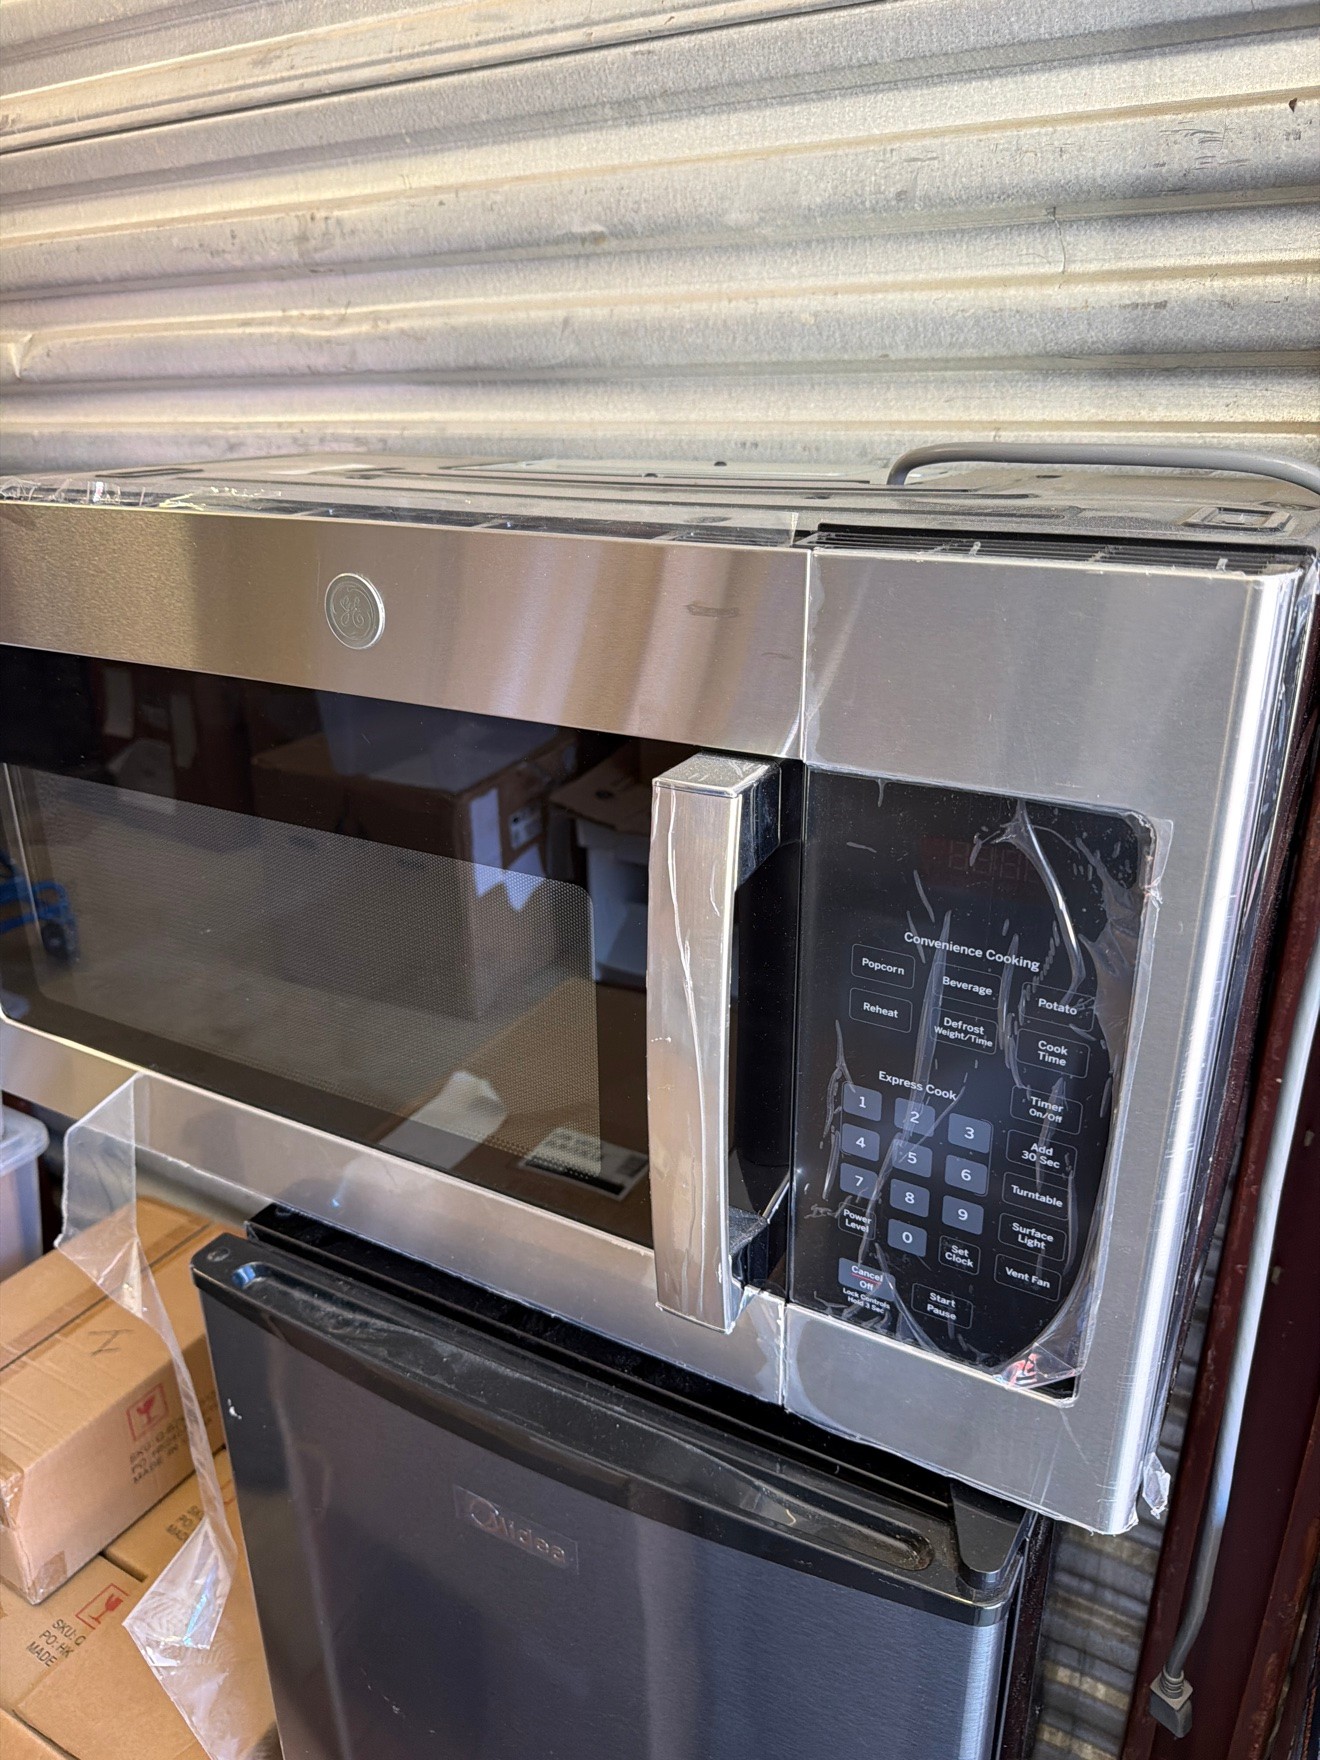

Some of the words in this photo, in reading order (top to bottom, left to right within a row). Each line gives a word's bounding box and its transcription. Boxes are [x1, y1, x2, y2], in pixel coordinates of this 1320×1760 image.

[904, 932, 983, 958] Convenience
[986, 949, 1041, 973] Cooking
[861, 957, 905, 975] Popcorn
[942, 976, 993, 996] Beverage
[863, 1002, 898, 1018] Reheat
[1038, 998, 1078, 1016] Potato
[943, 1017, 985, 1035] Defrost
[934, 1025, 993, 1047] Weight/Time
[1038, 1040, 1068, 1056] Cook
[1037, 1052, 1067, 1067] Time
[878, 1070, 923, 1091] Express
[925, 1083, 957, 1101] Cook
[859, 1096, 867, 1108] 1
[1030, 1096, 1064, 1113] Timer
[910, 1111, 920, 1124] 2
[1029, 1108, 1063, 1124] On/Off
[964, 1127, 975, 1140] 3
[855, 1137, 866, 1148] 4
[1031, 1142, 1054, 1157] Add
[907, 1152, 918, 1164] 5
[1021, 1151, 1036, 1162] 30
[1038, 1155, 1061, 1169] Sec
[854, 1175, 864, 1187] 7
[961, 1169, 972, 1181] 6
[905, 1192, 915, 1204] 8
[1011, 1185, 1063, 1208] Turntable
[843, 1209, 872, 1225] Power
[958, 1209, 968, 1221] 9
[845, 1218, 869, 1233] Level
[1011, 1222, 1054, 1243] Surface
[902, 1231, 913, 1244] 0
[1018, 1233, 1046, 1250] Light
[944, 1251, 974, 1268] Clock
[951, 1245, 970, 1258] Set
[851, 1265, 883, 1282] Cancel
[1005, 1267, 1029, 1283] Vent
[1031, 1273, 1050, 1288] Fan
[859, 1280, 874, 1291] Off
[842, 1287, 859, 1298] Lock
[860, 1294, 890, 1309] Controls
[847, 1296, 864, 1307] Hold
[871, 1303, 884, 1314] Sec
[929, 1292, 956, 1308] Start
[926, 1304, 957, 1321] Pause
[52, 1618, 77, 1641] SKU:
[39, 1629, 59, 1648] PO:
[55, 1642, 74, 1658] HK
[26, 1640, 58, 1668] MADE
